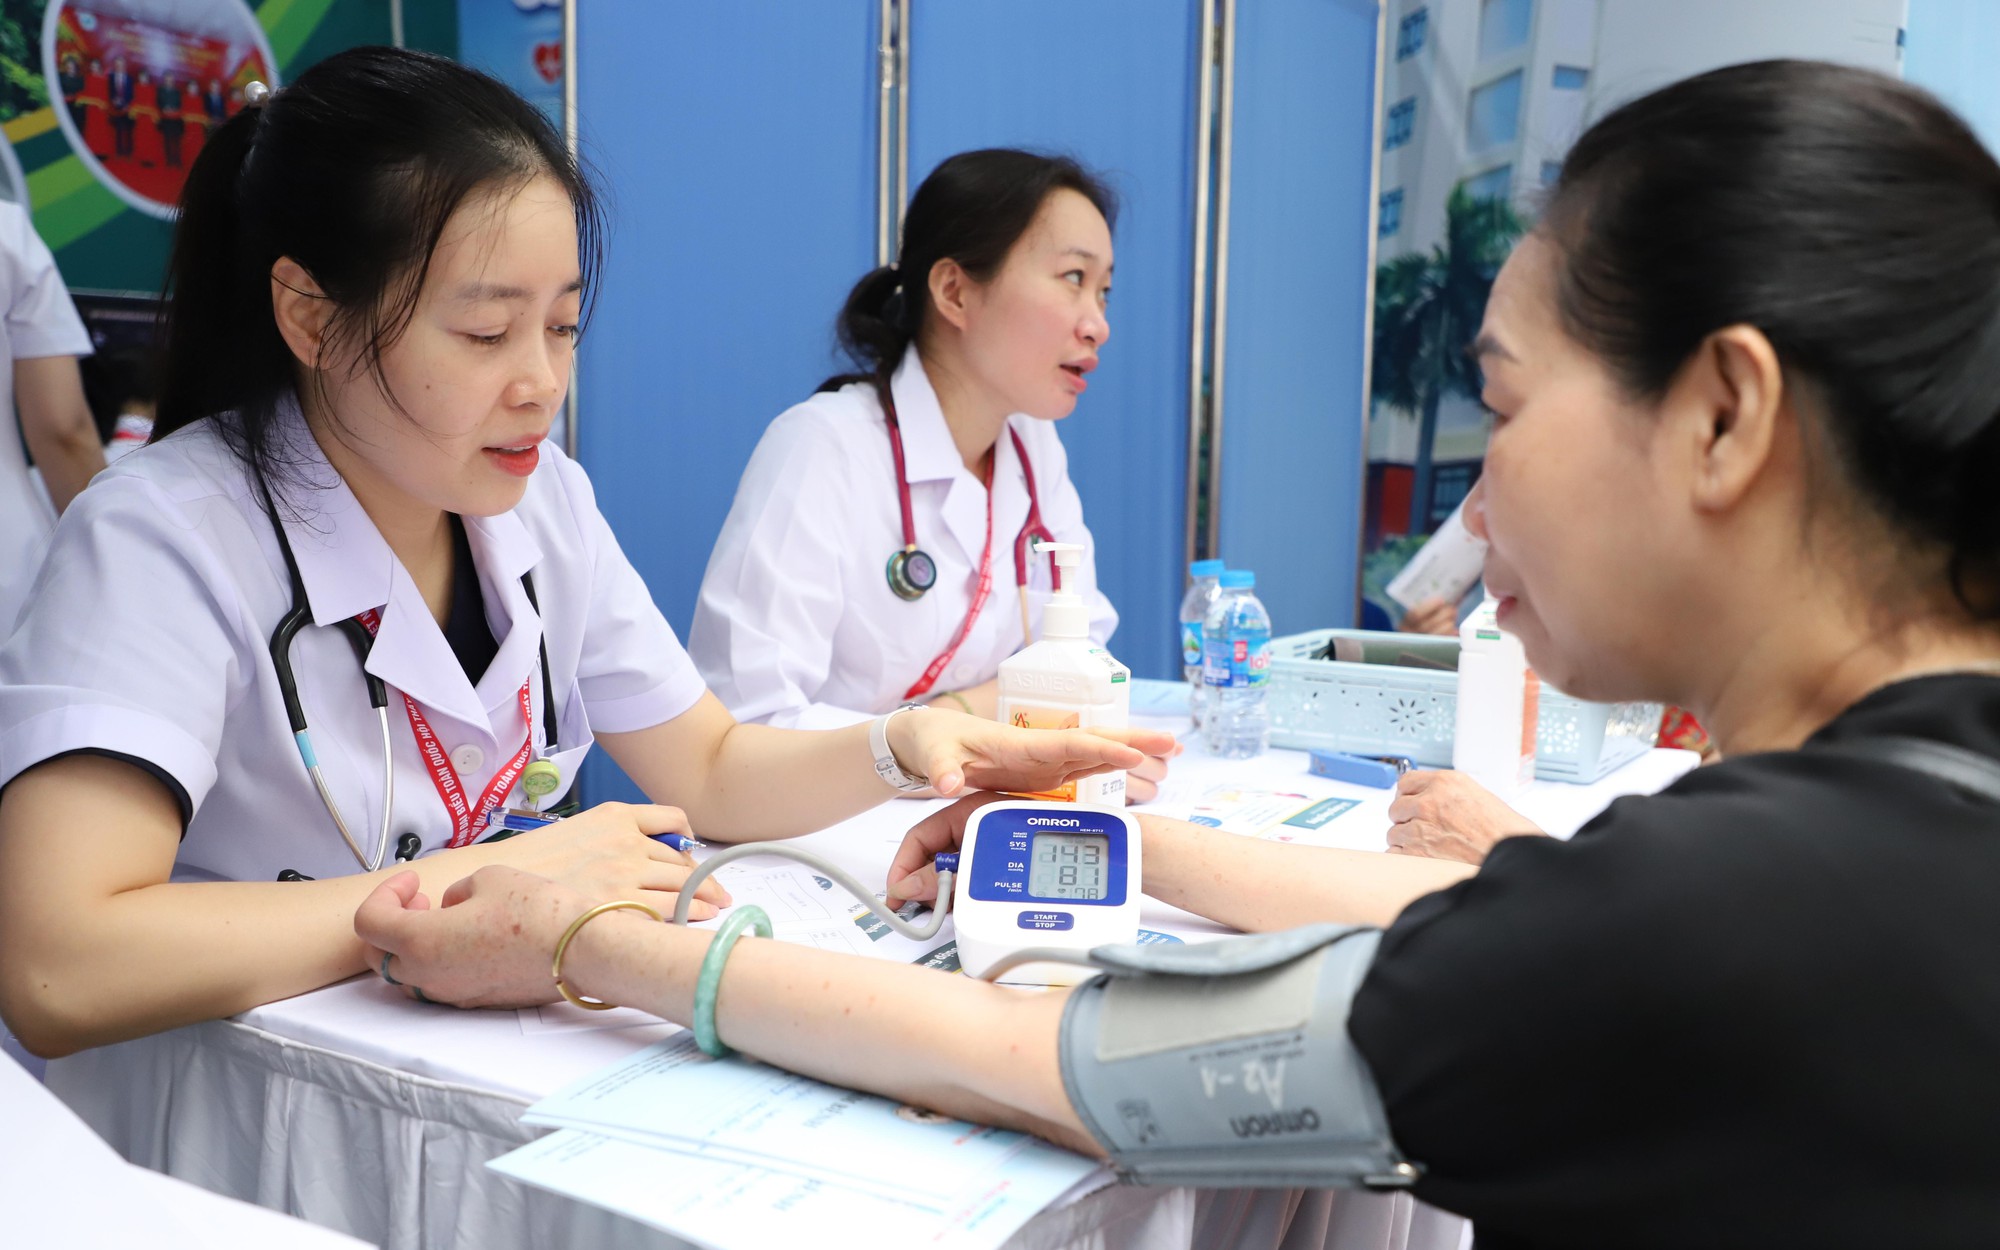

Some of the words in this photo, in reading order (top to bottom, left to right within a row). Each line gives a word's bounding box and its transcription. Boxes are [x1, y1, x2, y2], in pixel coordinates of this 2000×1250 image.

[416, 723, 432, 739] HỘI
[424, 741, 445, 767] QUỐC
[437, 766, 457, 793] TOÀN
[493, 768, 517, 794] TOÀN
[512, 744, 531, 770] QUỐC
[449, 792, 466, 816] BIỂU
[1052, 844, 1099, 865] 143
[1059, 866, 1099, 885] 81
